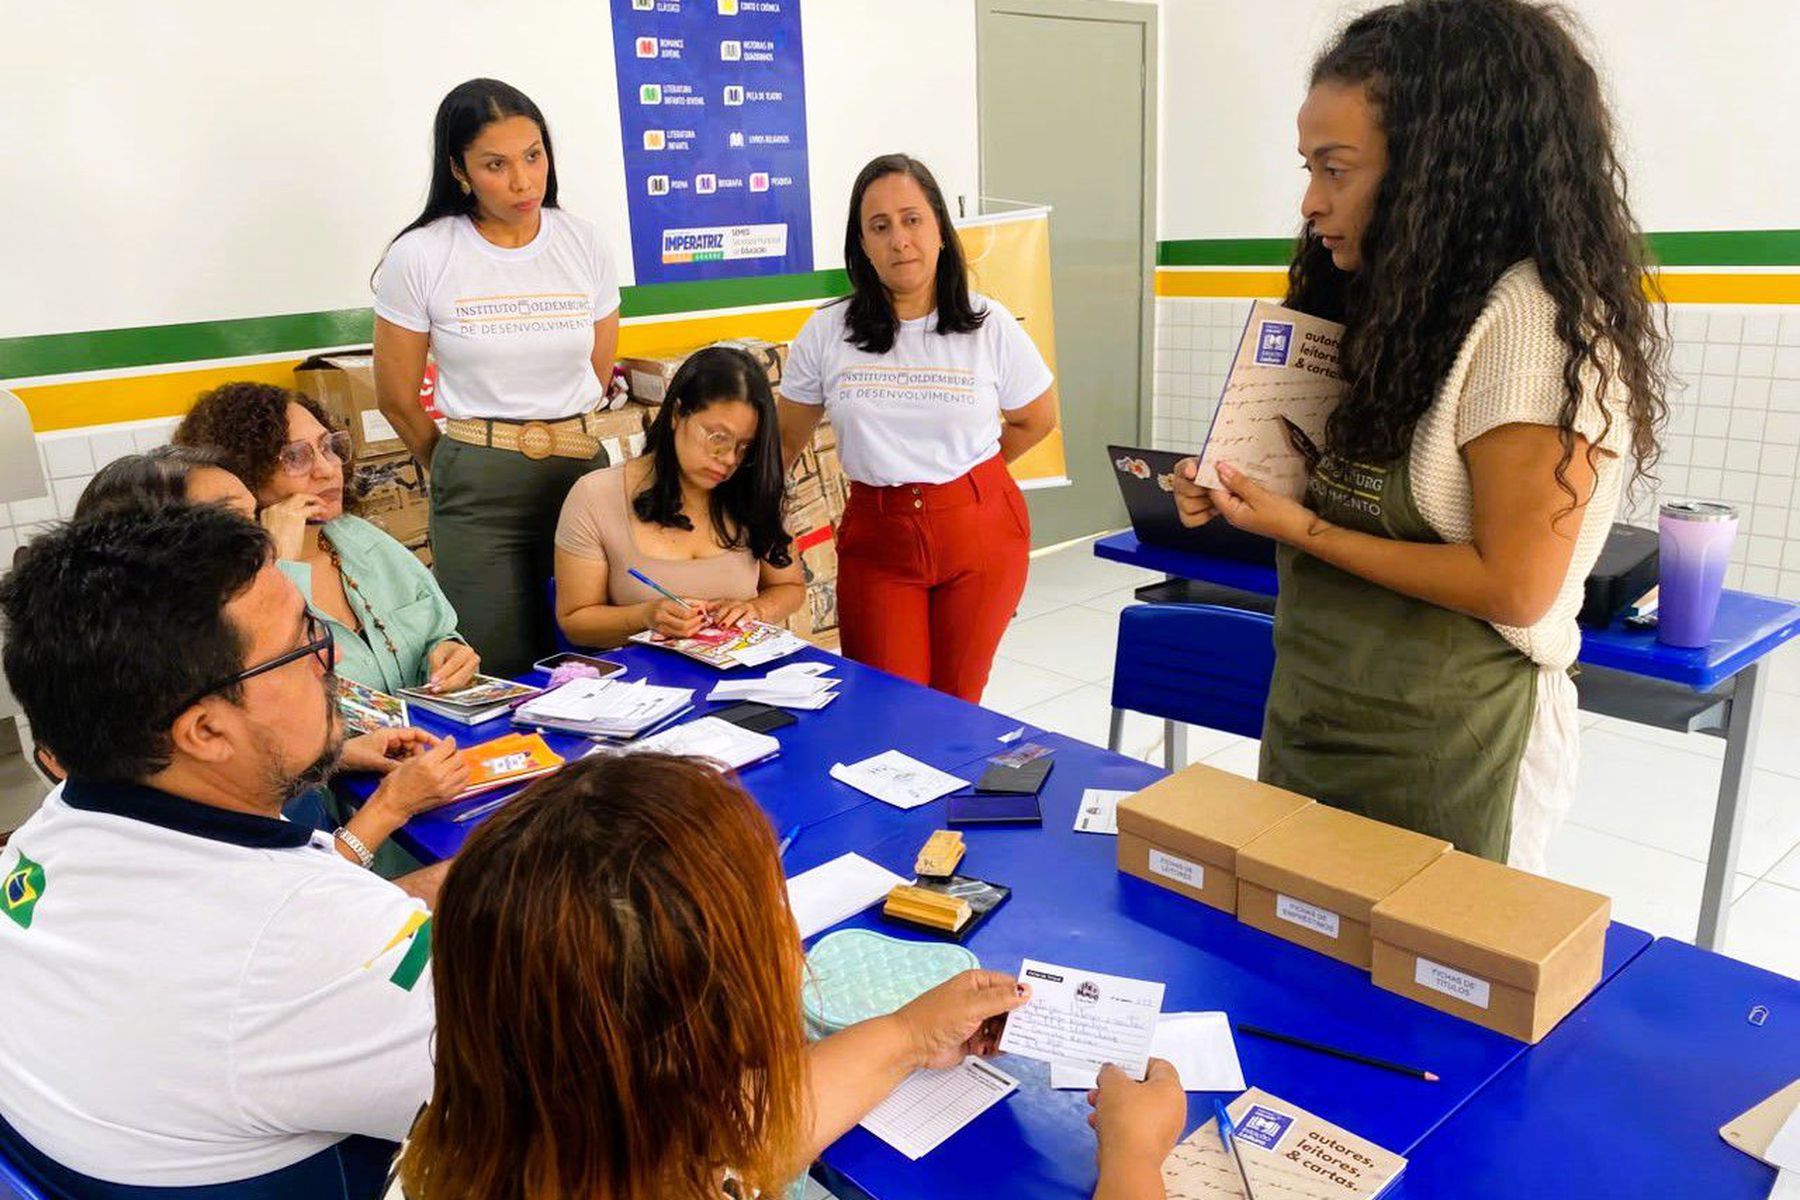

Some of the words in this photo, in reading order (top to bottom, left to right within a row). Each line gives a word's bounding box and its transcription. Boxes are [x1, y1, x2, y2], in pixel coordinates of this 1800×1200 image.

[664, 233, 724, 251] IMPERATRIZ
[456, 302, 517, 317] INSTITUTO
[460, 324, 476, 335] DE
[1294, 357, 1305, 369] &
[909, 372, 976, 386] OLDEMBURG
[856, 388, 976, 405] DESENVOLVIMENTO
[1296, 1138, 1362, 1177] leitores,
[1308, 1130, 1375, 1168] autores,
[1284, 1151, 1299, 1163] &
[1302, 1160, 1358, 1192] cartas.
